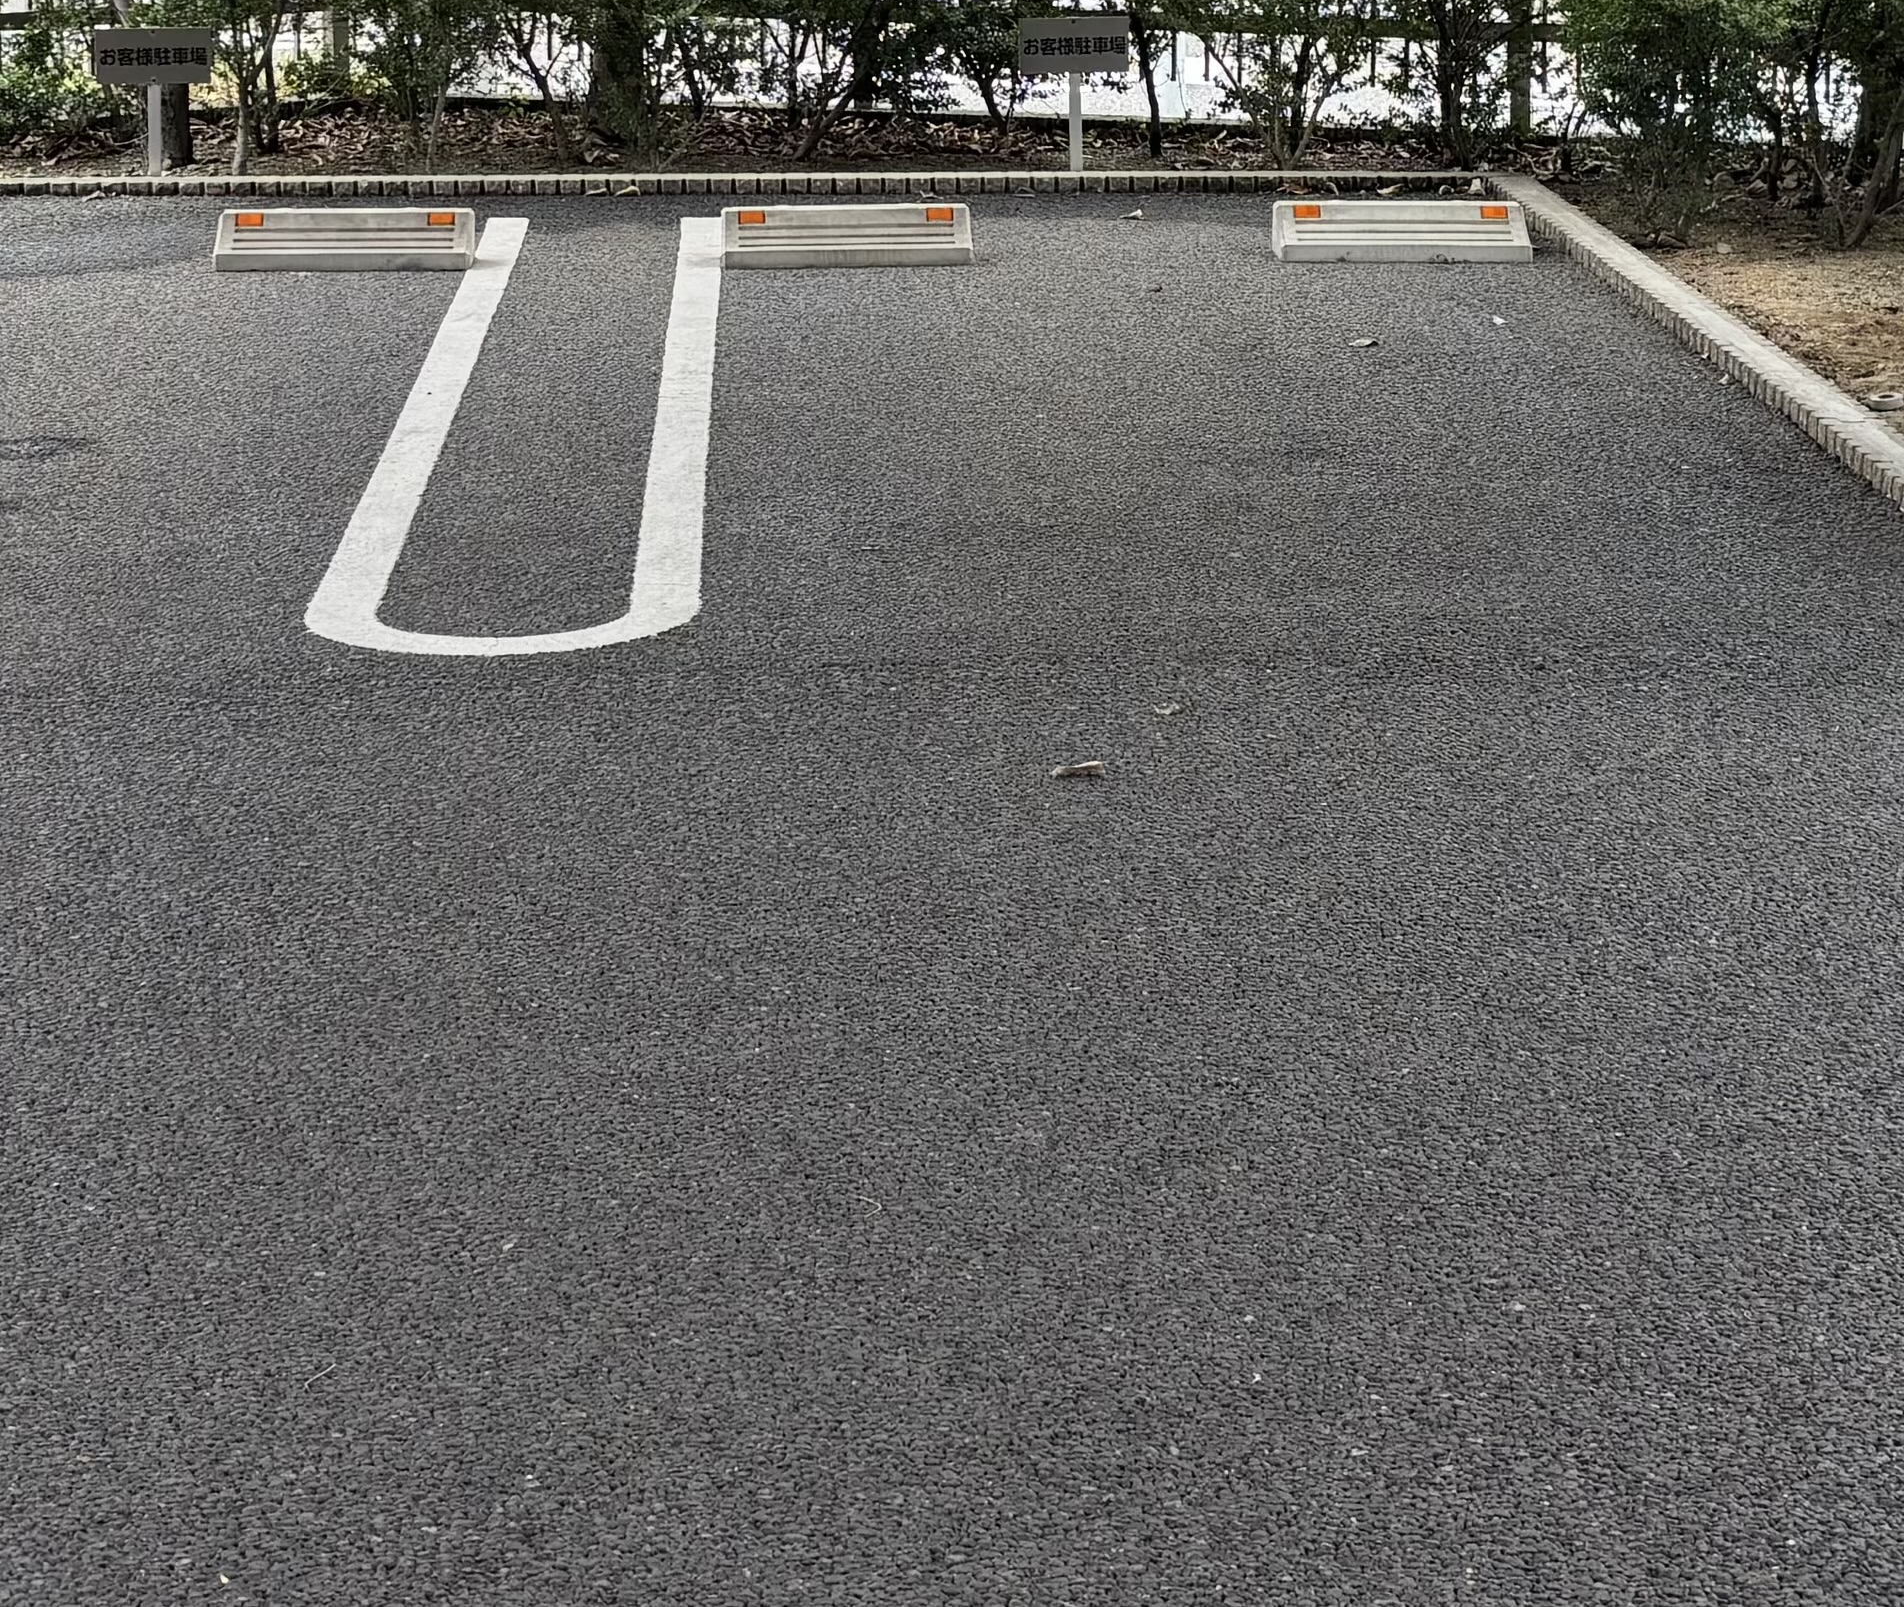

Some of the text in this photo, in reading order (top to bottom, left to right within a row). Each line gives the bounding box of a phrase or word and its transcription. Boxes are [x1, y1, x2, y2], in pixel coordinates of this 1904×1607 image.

[1021, 36, 1126, 56] お客様駐車場
[99, 47, 208, 66] お客様駐車場
